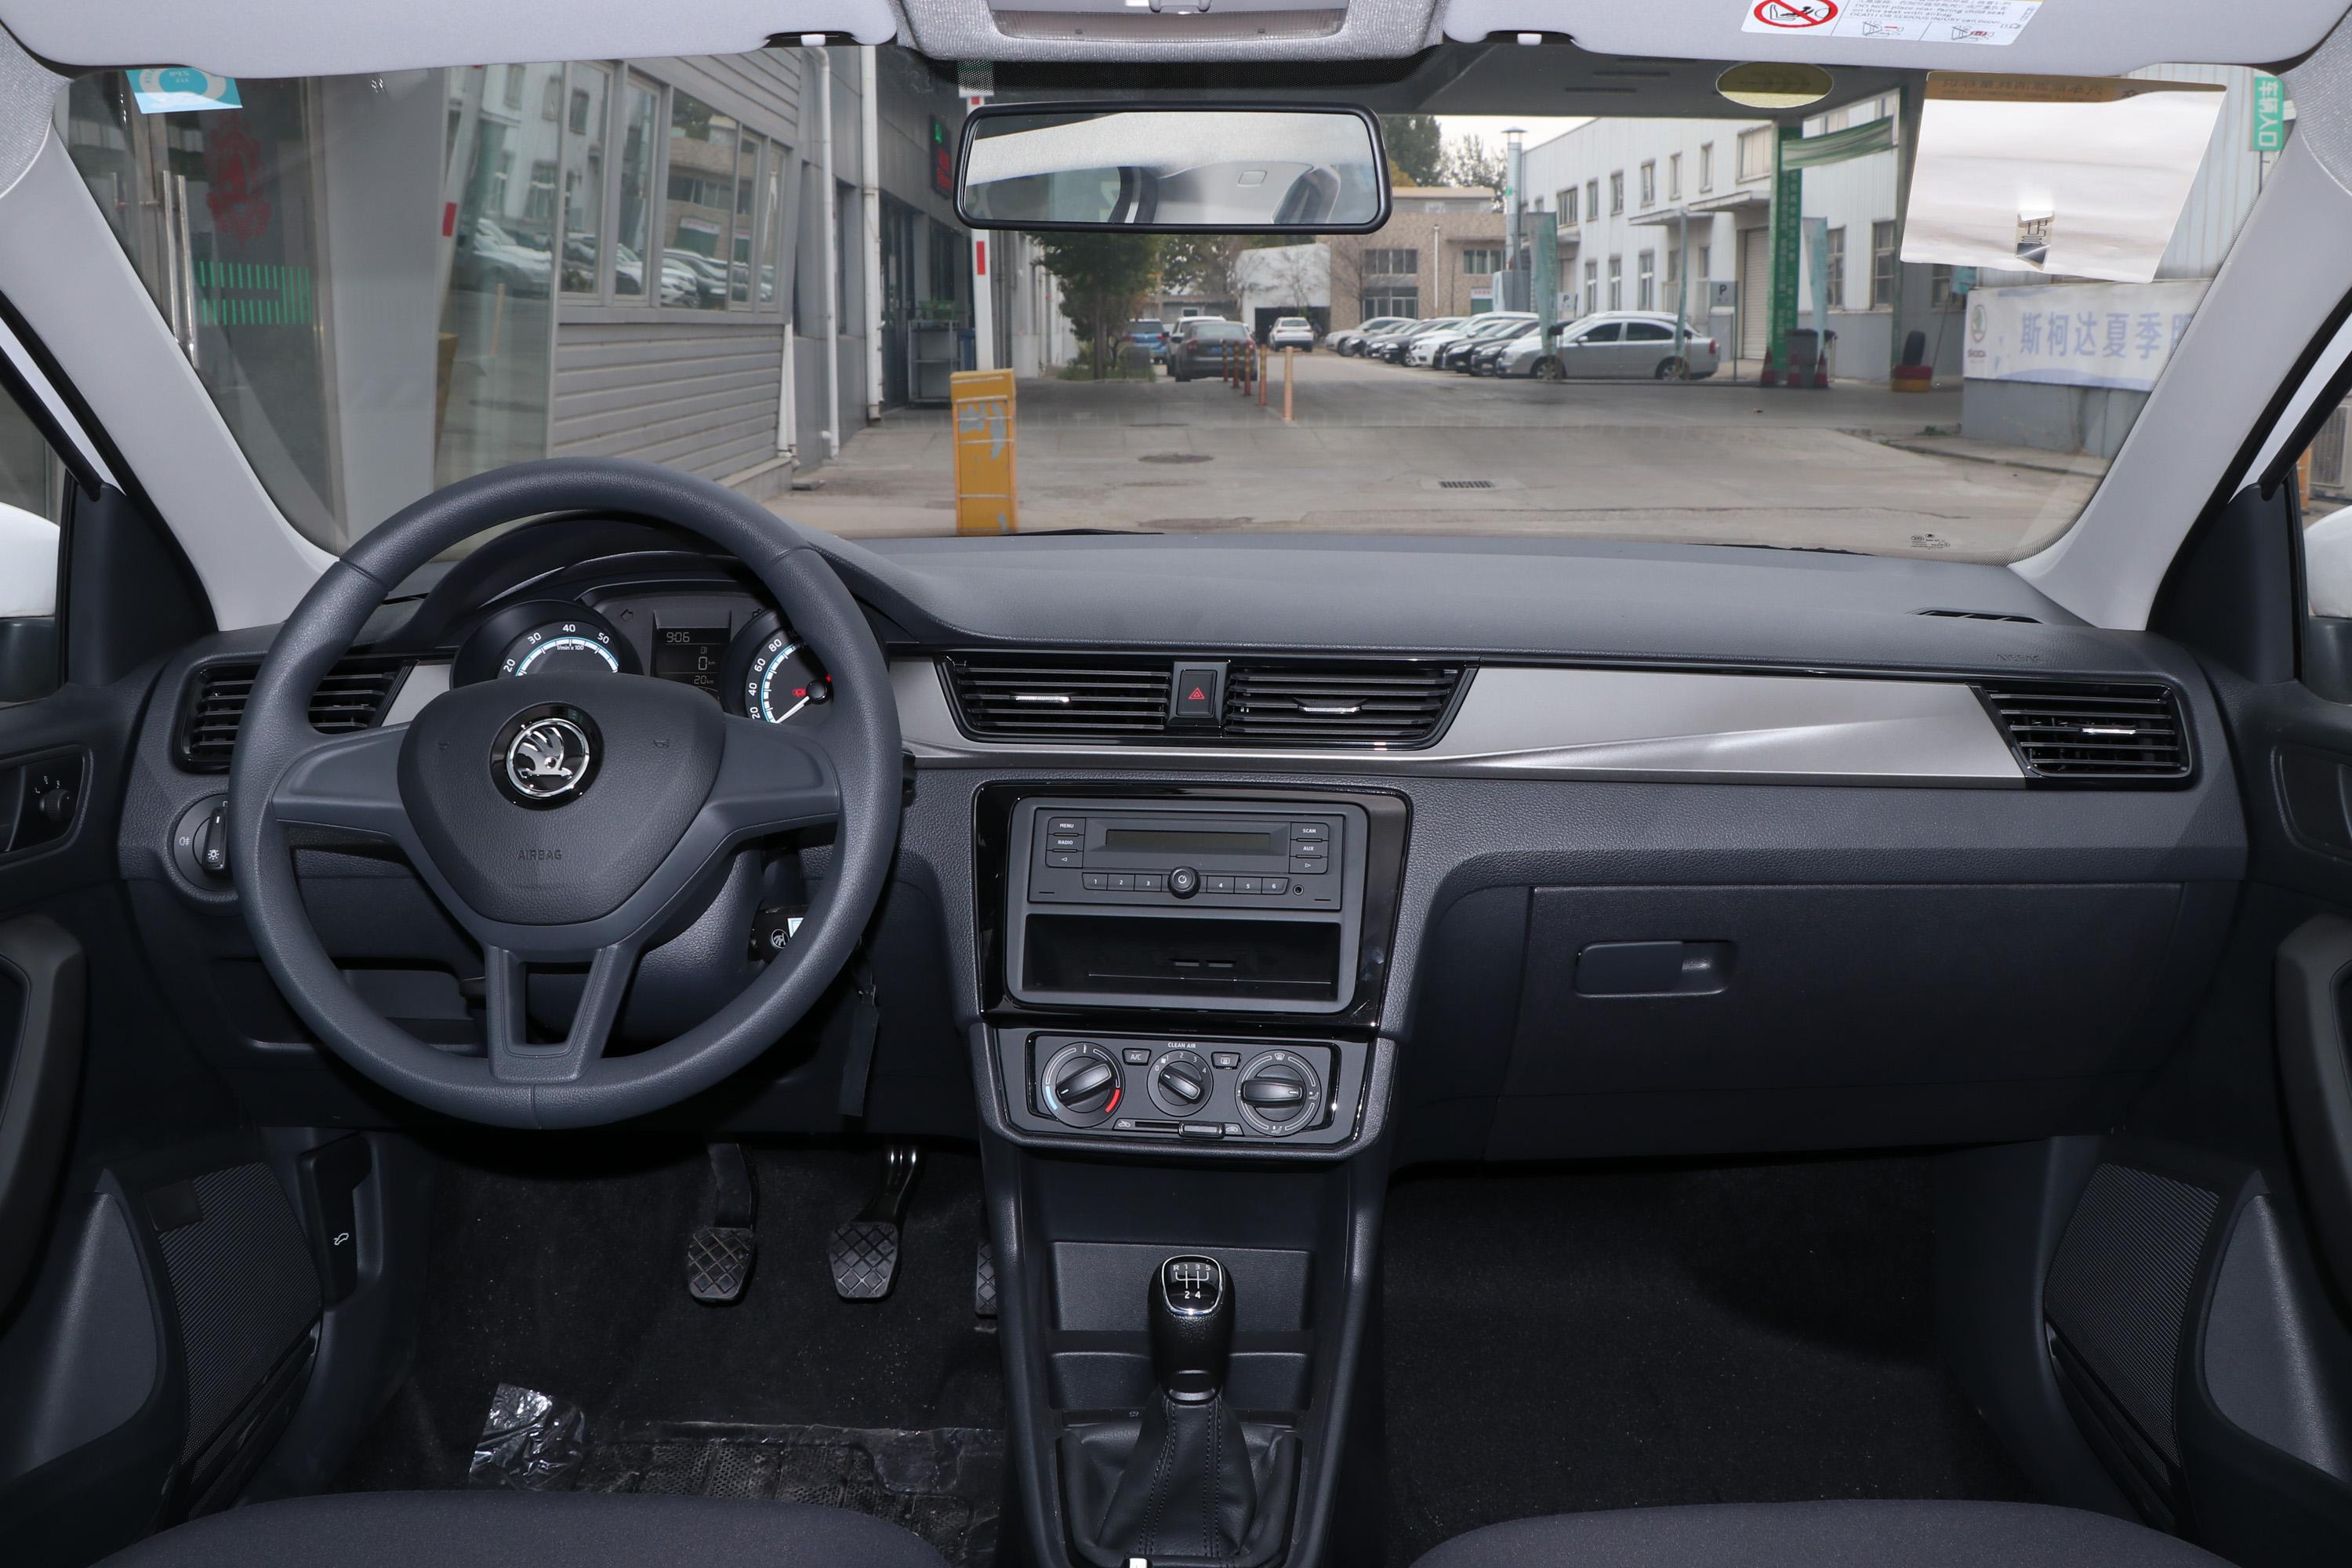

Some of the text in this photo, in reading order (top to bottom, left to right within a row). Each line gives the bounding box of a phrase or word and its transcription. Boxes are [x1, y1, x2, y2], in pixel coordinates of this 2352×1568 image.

[2258, 80, 2278, 147] 车辆入口
[1718, 284, 1728, 296] P
[1563, 295, 1569, 303] P
[562, 624, 576, 633] 40
[527, 632, 542, 645] 30
[597, 632, 610, 645] 50
[666, 632, 690, 643] 9:06
[768, 639, 782, 652] 80
[503, 659, 516, 673] 20
[698, 656, 708, 670] 0
[754, 658, 766, 672] 60
[694, 675, 707, 684] 20
[748, 682, 757, 696] 40
[750, 706, 760, 719] 20
[517, 849, 563, 860] AIRBAG
[1184, 1290, 1201, 1299] 2 4
